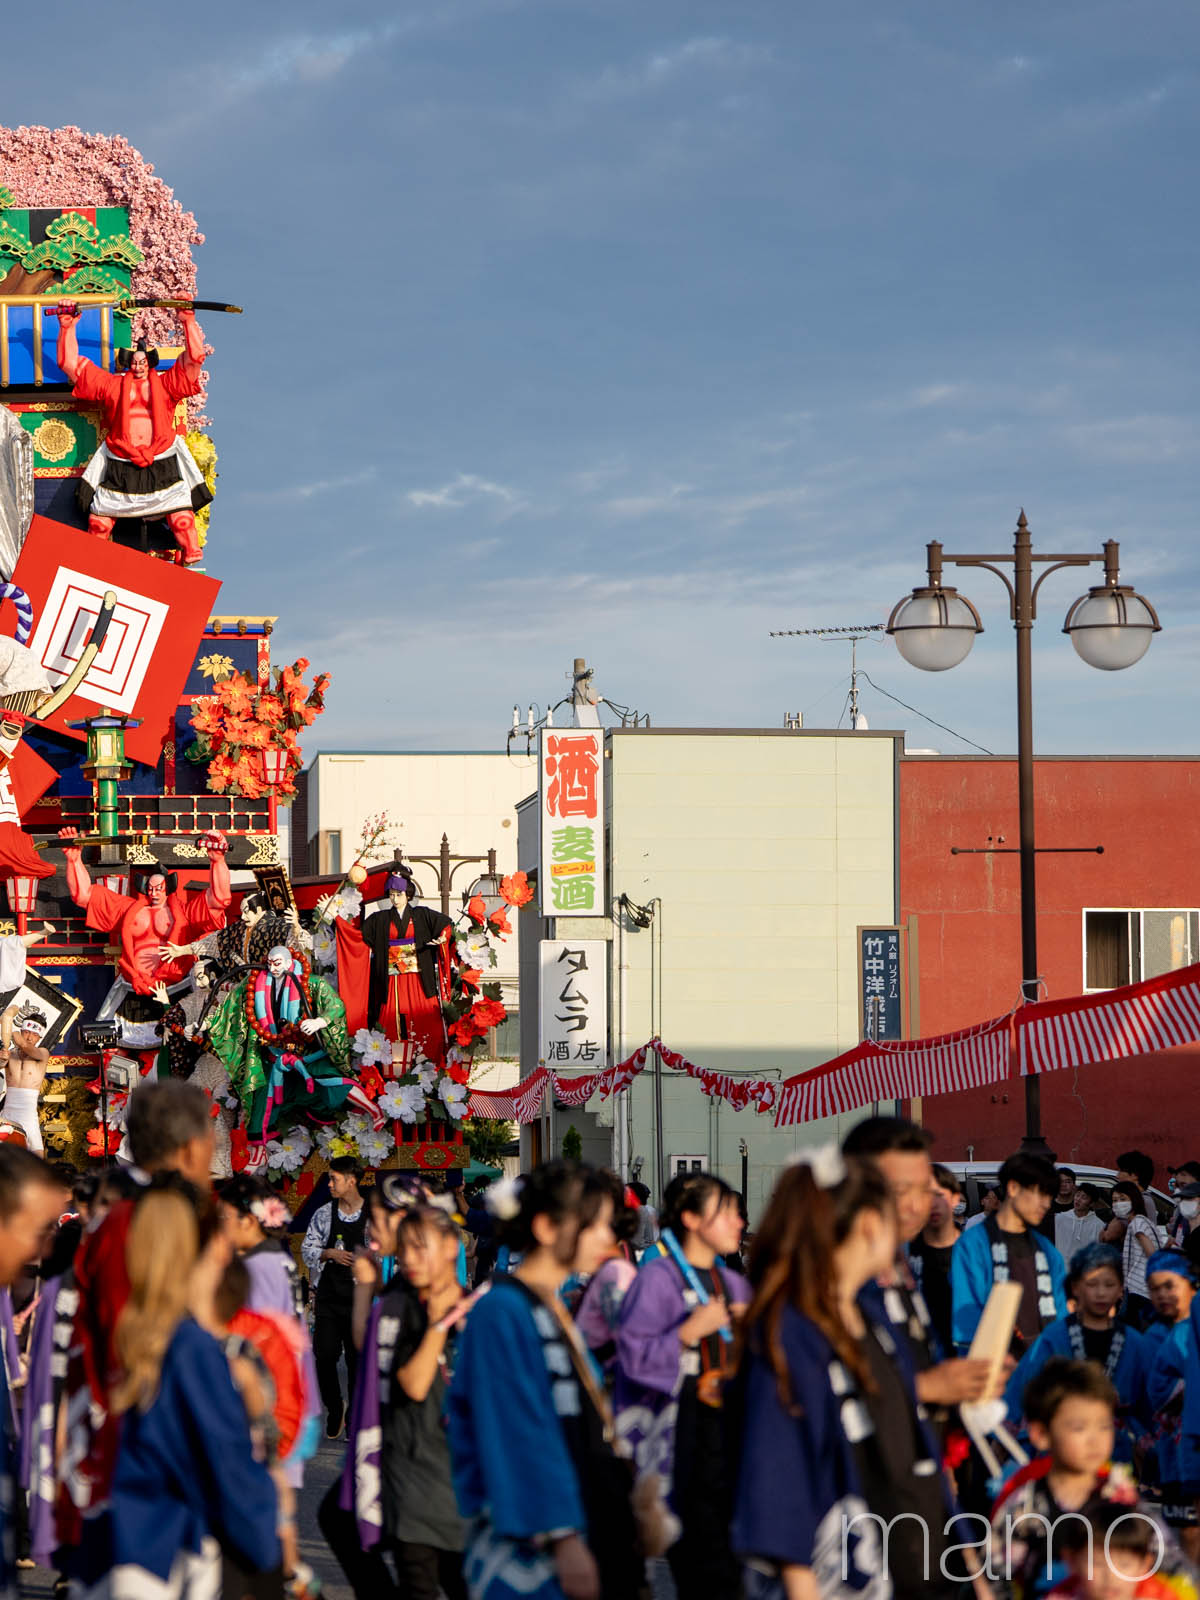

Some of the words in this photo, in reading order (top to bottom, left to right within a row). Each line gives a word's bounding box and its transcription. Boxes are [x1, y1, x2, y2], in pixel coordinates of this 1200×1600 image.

[545, 735, 599, 819] 酒
[553, 864, 593, 874] ビール
[554, 946, 589, 1033] タムラ
[889, 964, 898, 998] リフォーム
[548, 1040, 600, 1061] 酒店
